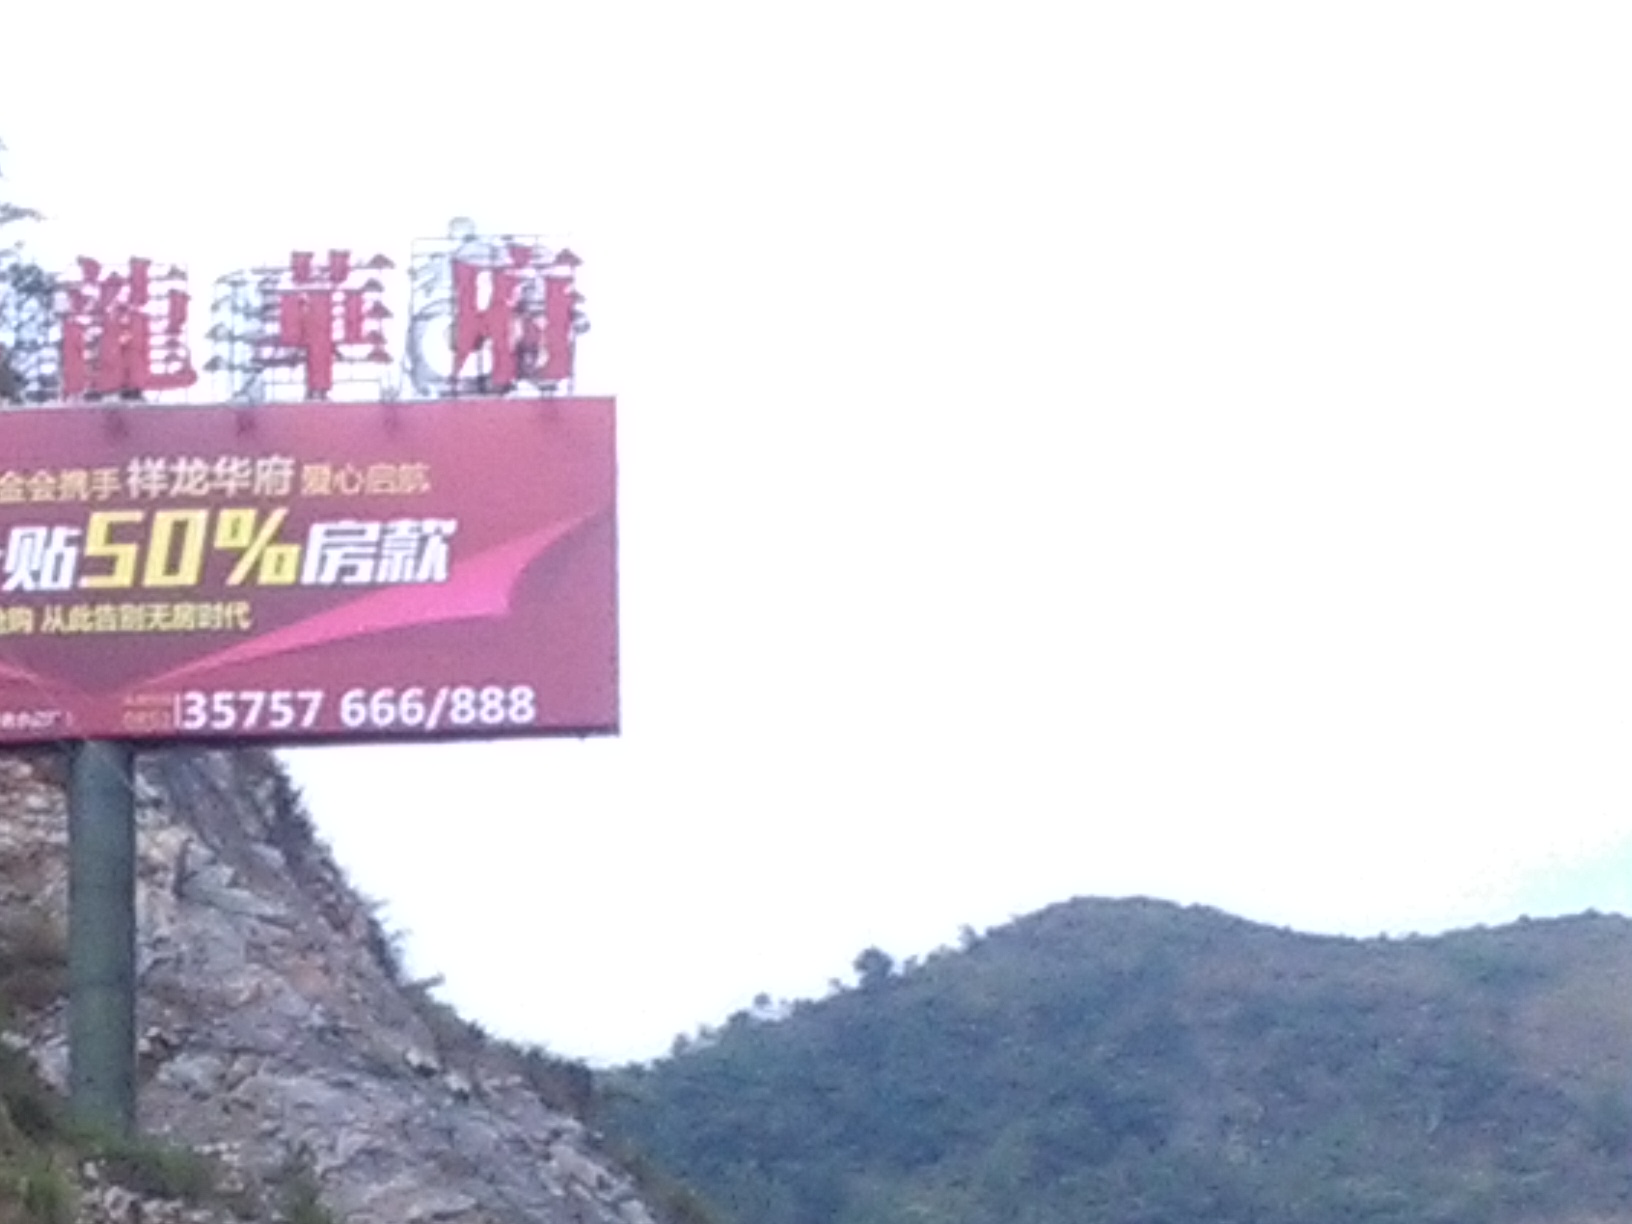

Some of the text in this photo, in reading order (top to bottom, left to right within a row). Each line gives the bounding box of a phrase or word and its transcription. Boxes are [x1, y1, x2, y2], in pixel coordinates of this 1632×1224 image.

[126, 454, 295, 498] 祥龙华府
[180, 688, 323, 730] 35757
[339, 684, 536, 730] 666/888
